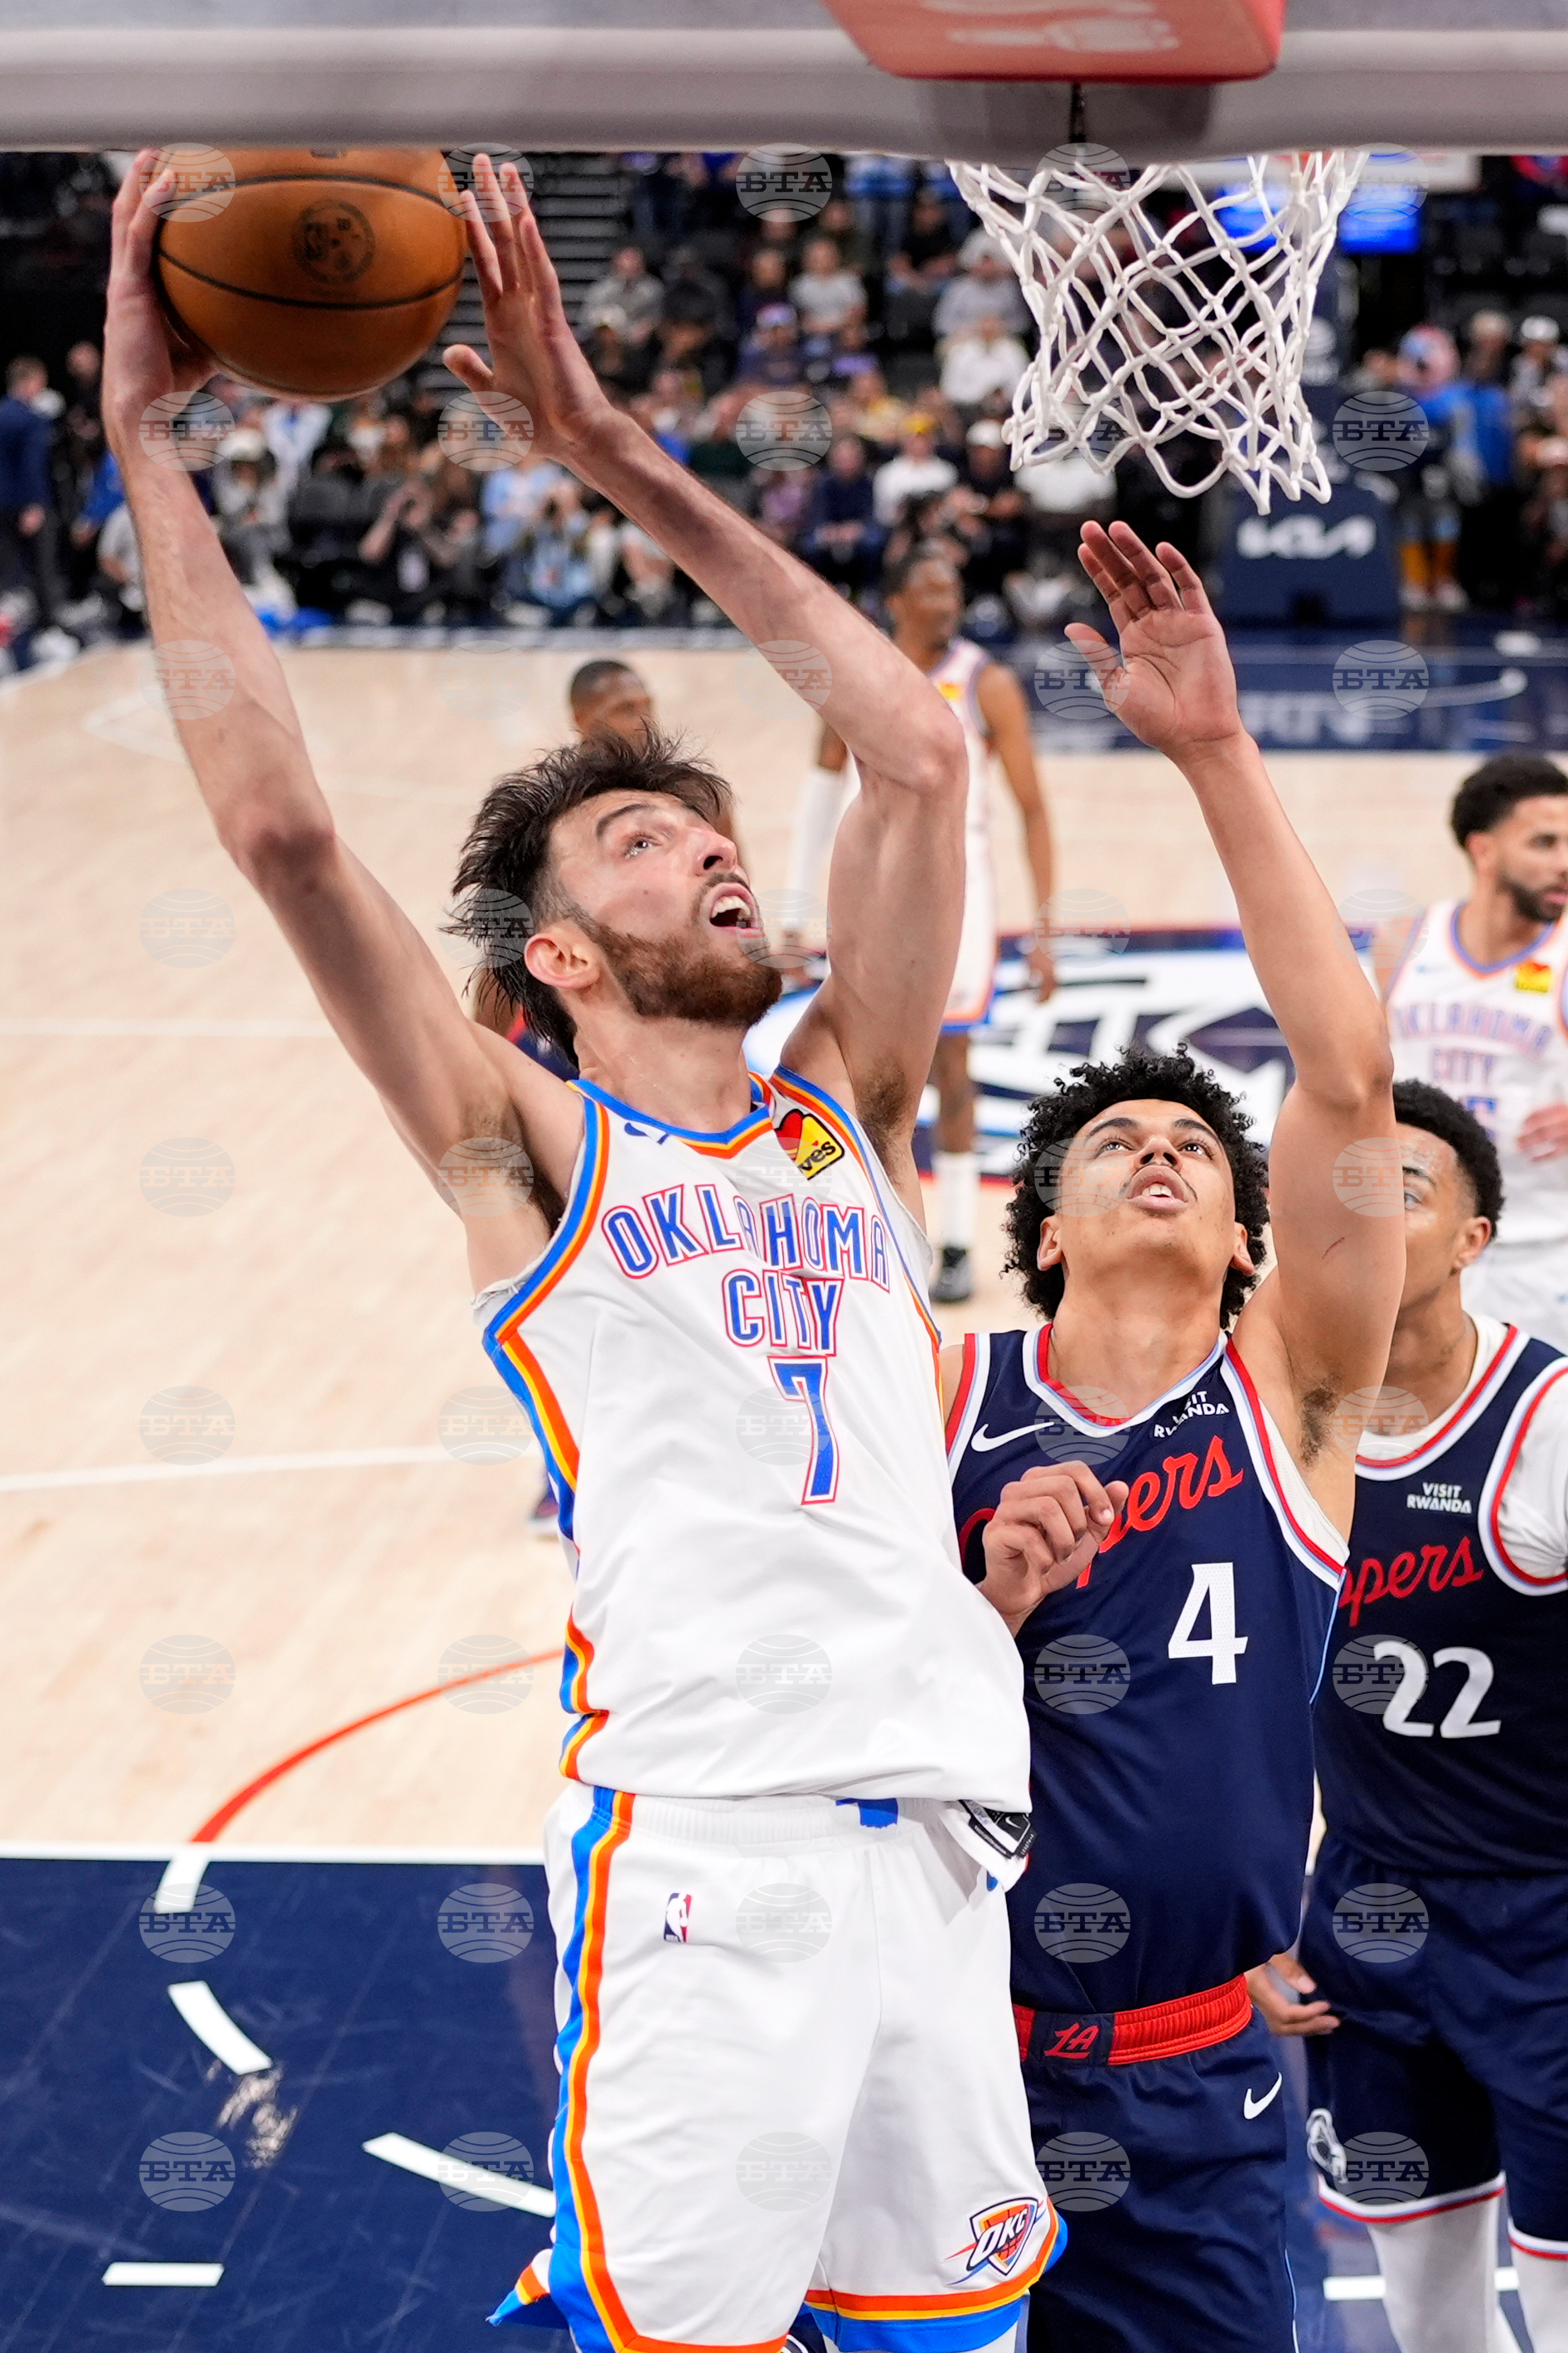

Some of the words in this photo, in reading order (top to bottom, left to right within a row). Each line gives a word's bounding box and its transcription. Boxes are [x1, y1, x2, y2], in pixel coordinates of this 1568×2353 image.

[601, 1184, 890, 1294] OKLAHOMA
[722, 1268, 844, 1356] CITY
[767, 1355, 840, 1505] 7
[1406, 1494, 1472, 1514] RWANDA
[1422, 1482, 1463, 1498] VISIT
[1168, 1562, 1248, 1684] 4
[1373, 1640, 1502, 1738] 22
[1045, 2022, 1100, 2060] LA
[967, 2206, 1029, 2269] OKC
